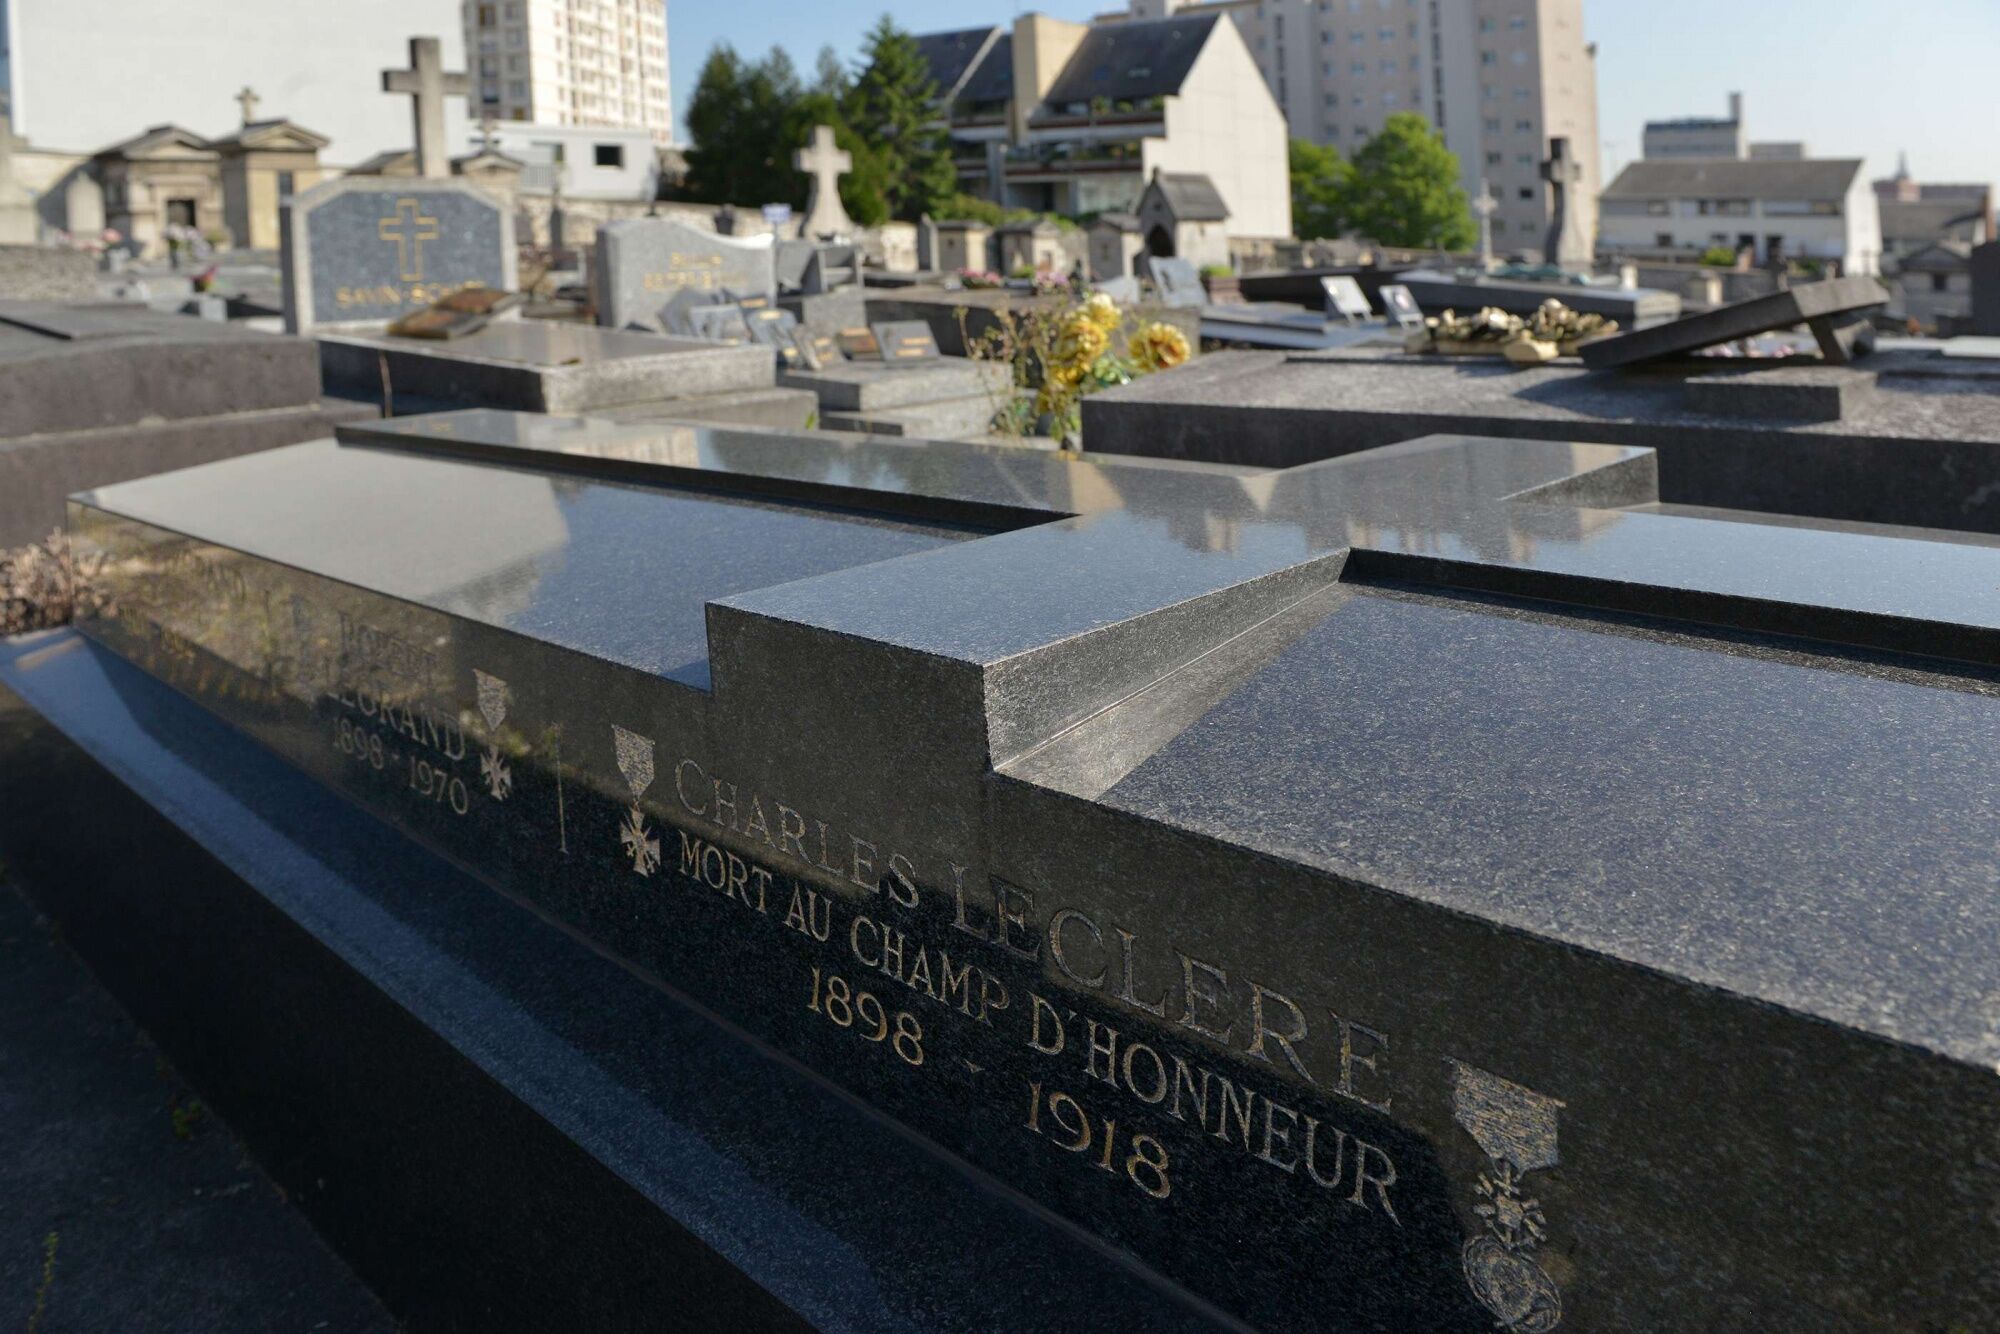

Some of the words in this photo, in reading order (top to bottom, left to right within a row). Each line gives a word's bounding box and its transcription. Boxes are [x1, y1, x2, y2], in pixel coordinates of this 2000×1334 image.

[410, 755, 469, 815] 1970
[674, 758, 920, 909] CHARLES
[948, 860, 1393, 1115] LECLERE
[677, 830, 773, 914] MORT
[783, 881, 833, 942] AU
[849, 915, 1011, 1028] CHAMP
[806, 965, 925, 1067] 1898
[1022, 1080, 1172, 1200] 1918
